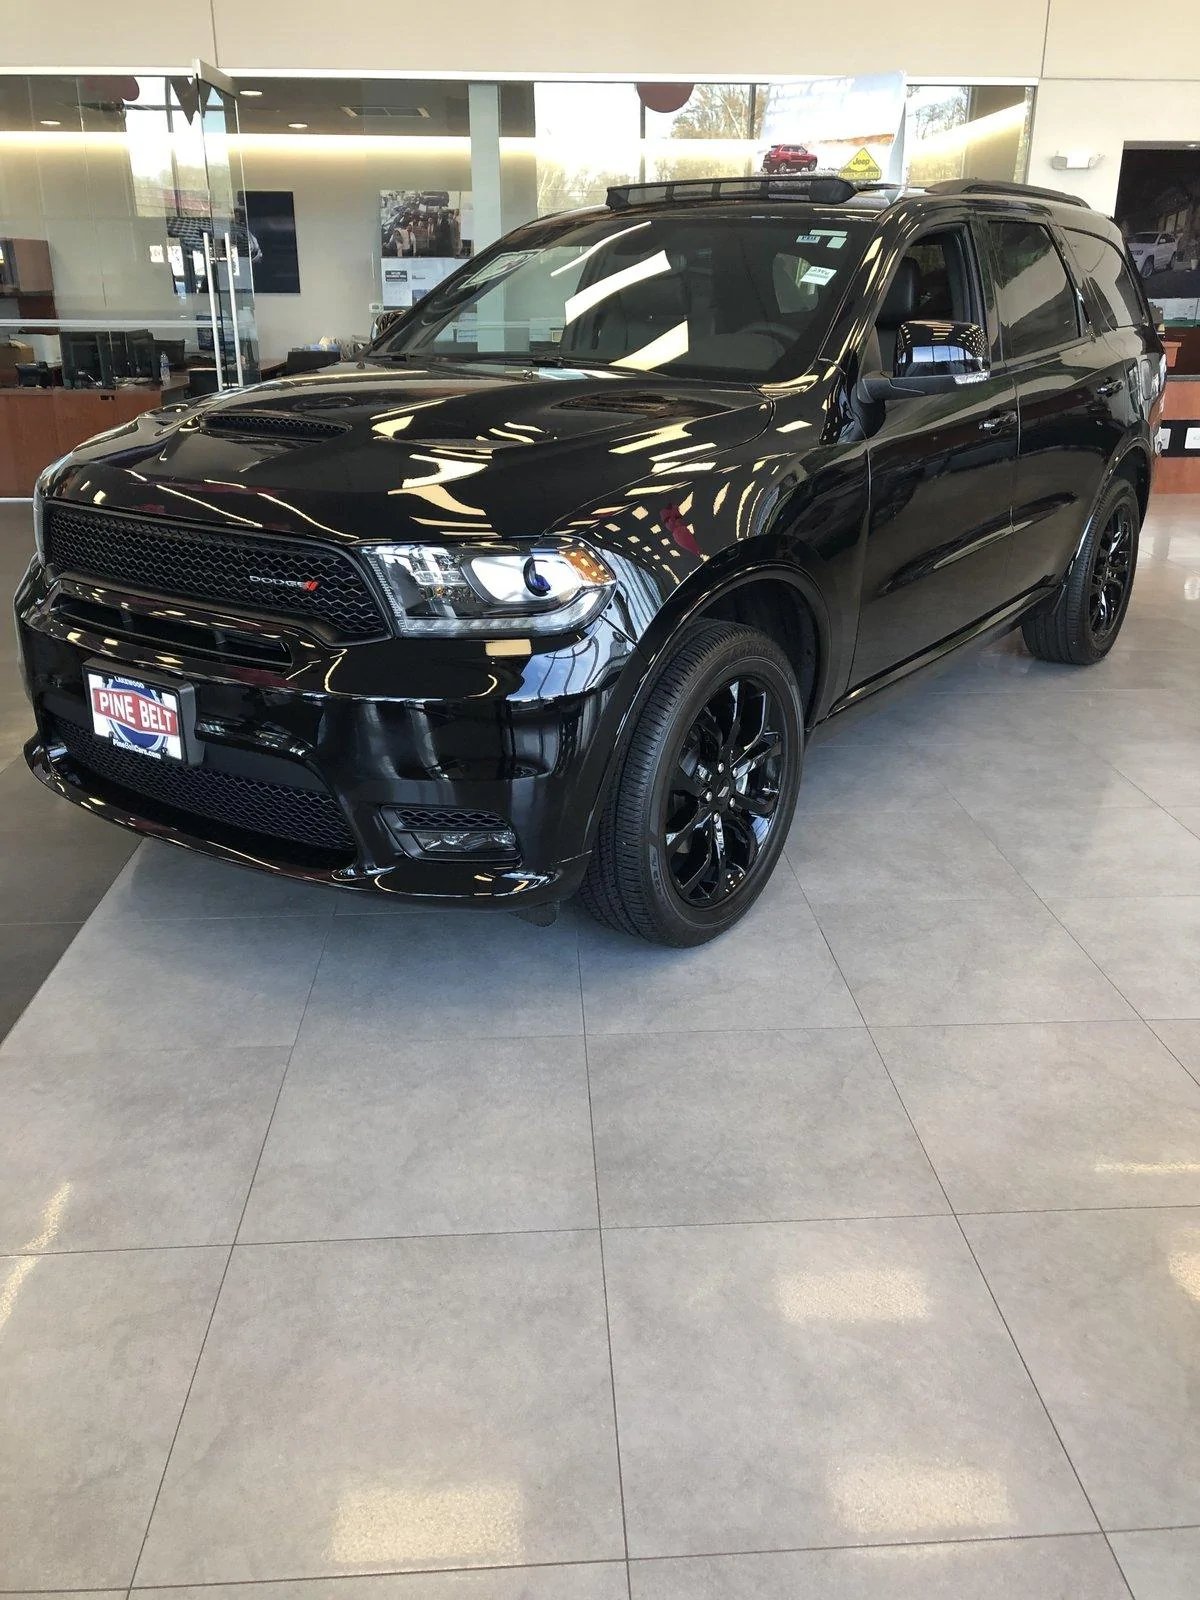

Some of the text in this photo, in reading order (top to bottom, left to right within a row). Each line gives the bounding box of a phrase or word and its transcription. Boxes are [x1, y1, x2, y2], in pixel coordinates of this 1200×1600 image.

[853, 158, 870, 166] Jeep
[249, 575, 305, 588] DODGE
[98, 691, 172, 732] PINE BELT
